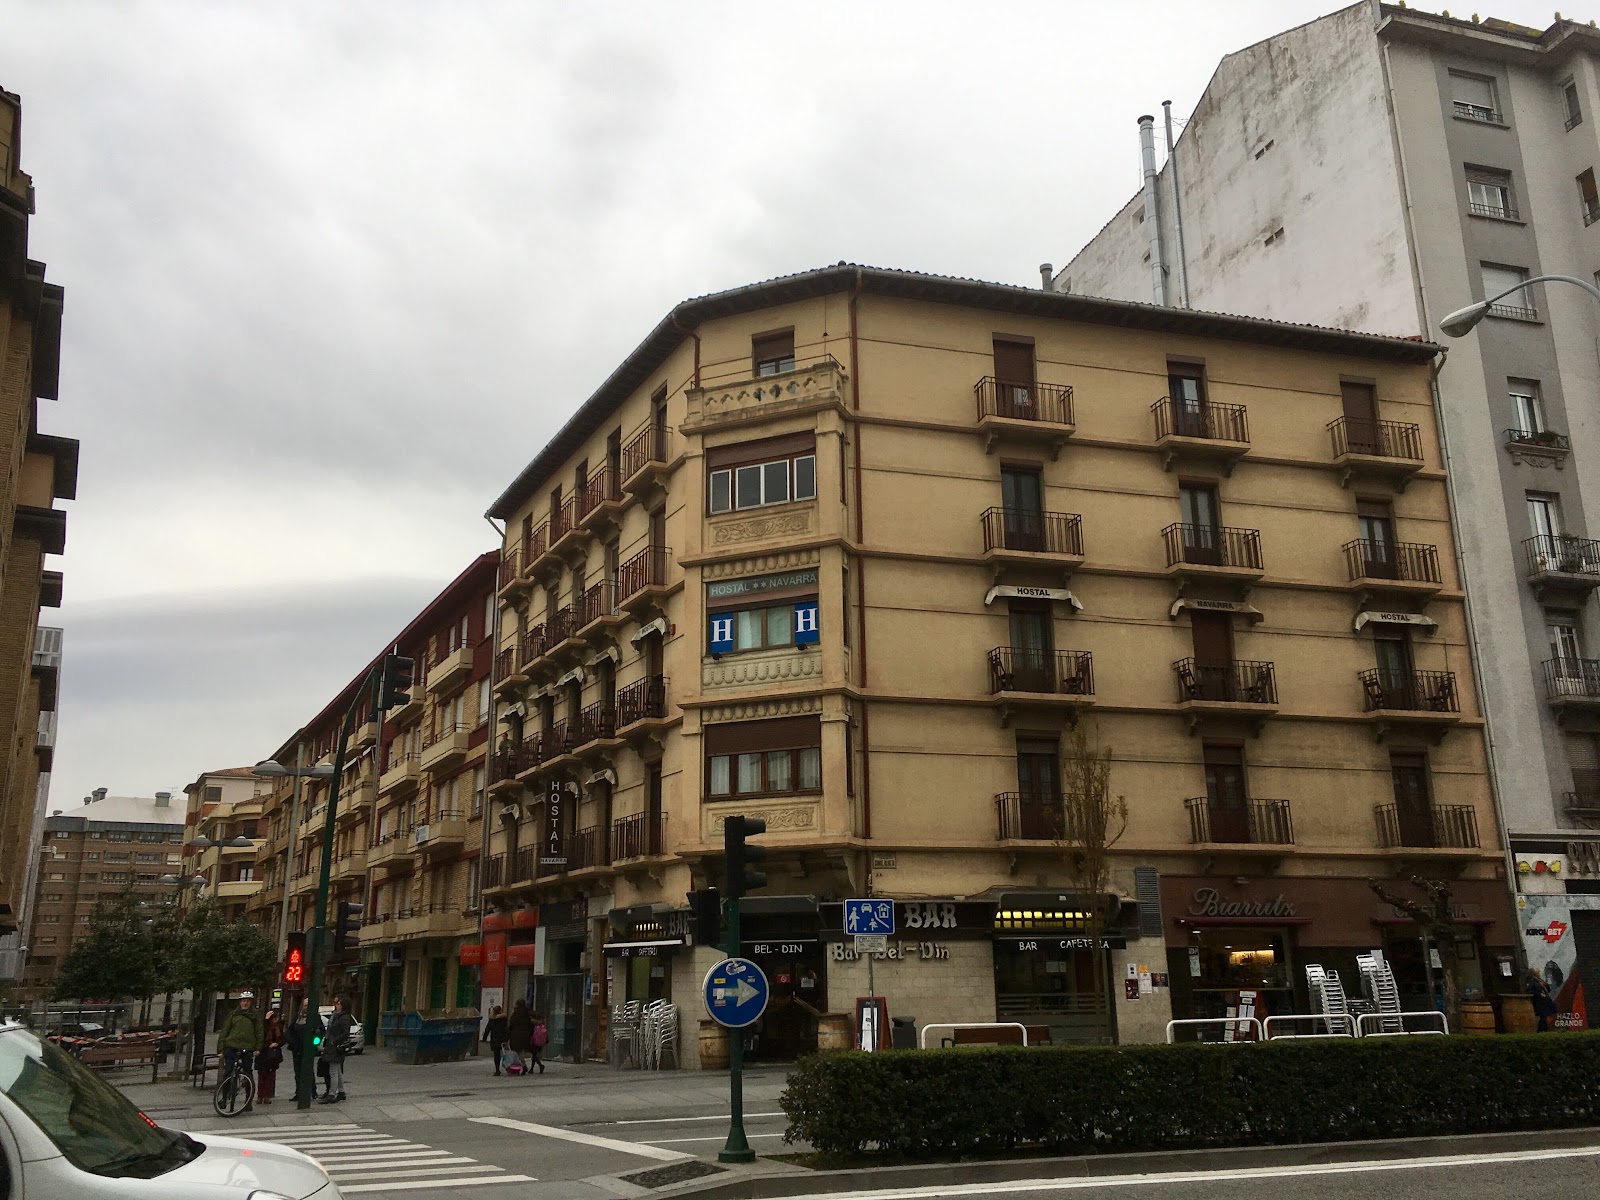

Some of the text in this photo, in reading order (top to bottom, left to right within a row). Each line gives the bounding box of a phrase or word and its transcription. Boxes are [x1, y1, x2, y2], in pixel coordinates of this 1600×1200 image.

[711, 573, 817, 596] HOSTAL NAVARRA
[1017, 587, 1050, 597] HOSTAL
[1197, 600, 1235, 610] NAVARRA
[795, 607, 819, 633] H
[1381, 613, 1411, 622] HOSTAL
[711, 618, 734, 643] H
[550, 781, 560, 854] HOSTAL
[1189, 887, 1297, 916] Biarritz
[904, 903, 957, 928] BAR
[1019, 941, 1038, 951] BAR
[286, 966, 301, 980] 22
[1554, 1019, 1584, 1027] GRANDE
[1556, 1012, 1580, 1020] HAZLO
